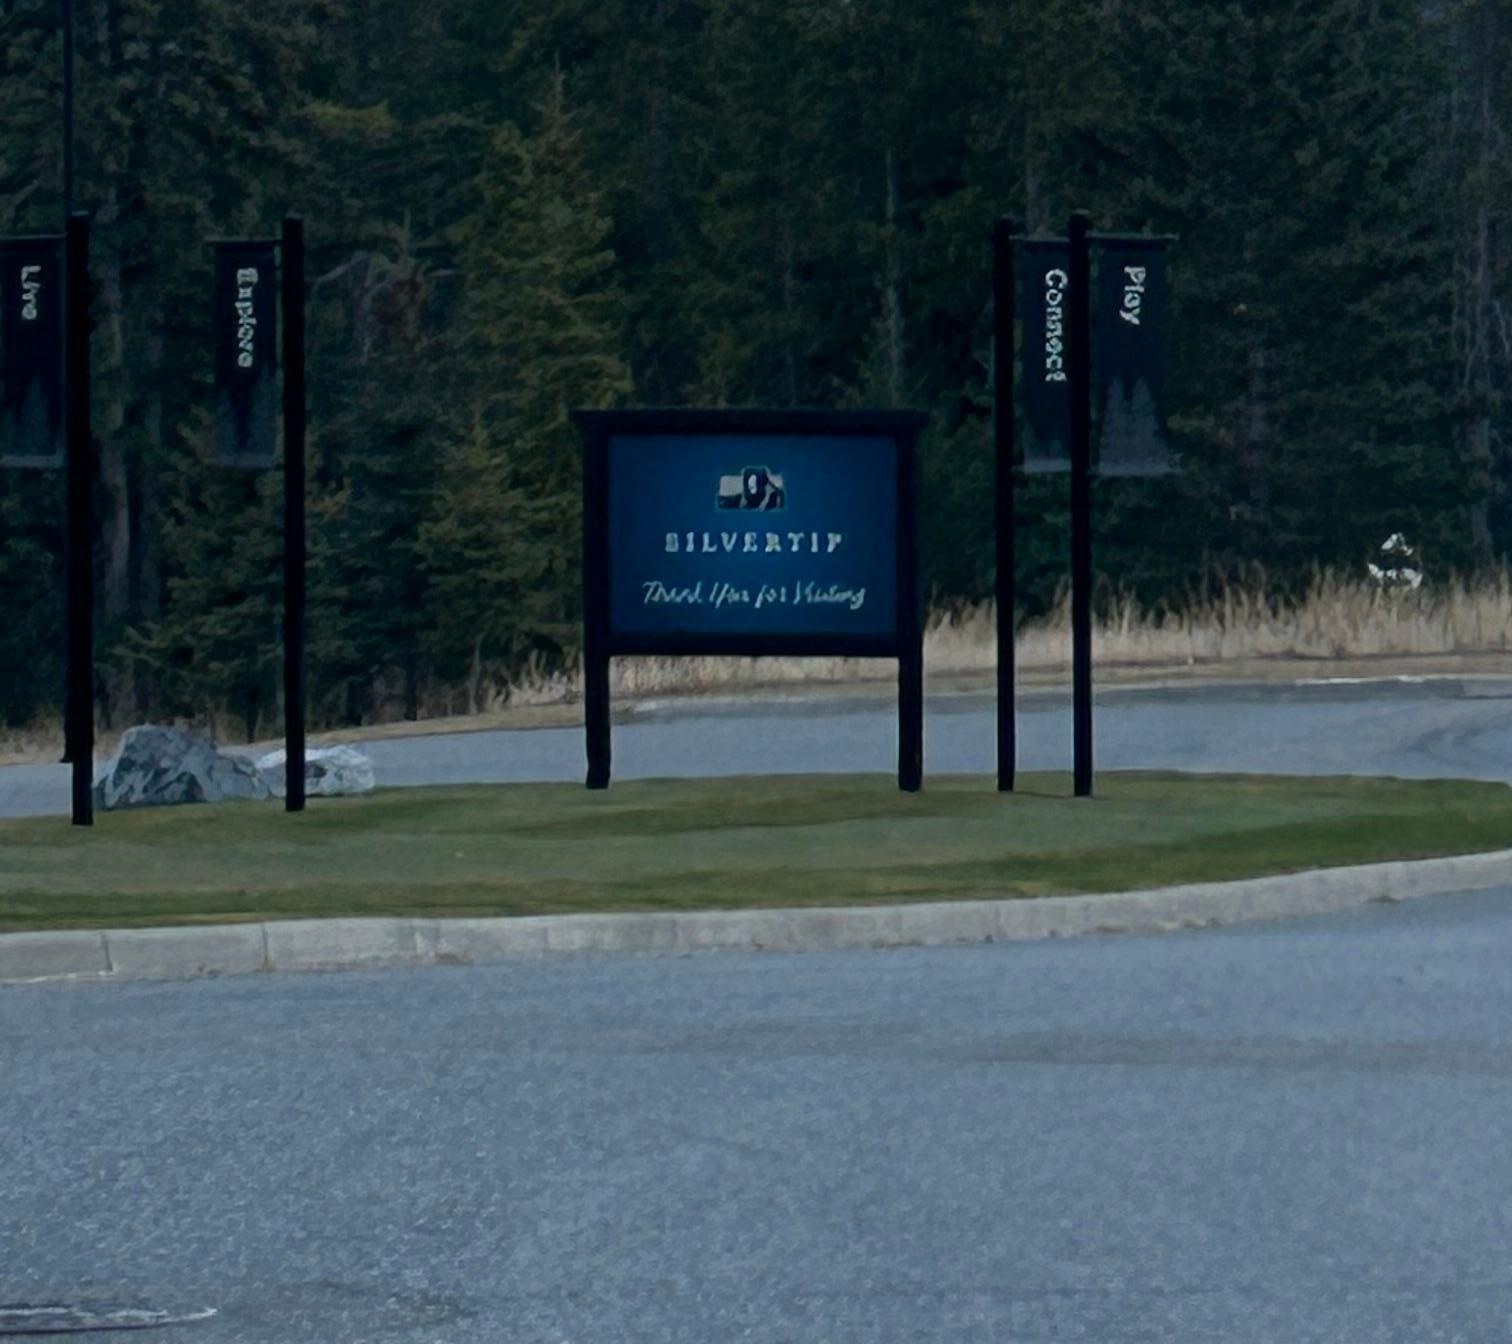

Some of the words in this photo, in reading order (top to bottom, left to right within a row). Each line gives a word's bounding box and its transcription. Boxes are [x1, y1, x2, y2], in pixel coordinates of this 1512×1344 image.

[21, 265, 41, 320] Live
[235, 267, 258, 367] Explore
[1119, 266, 1146, 325] Play
[1045, 268, 1068, 381] Connect
[665, 532, 842, 553] SILVERTIP
